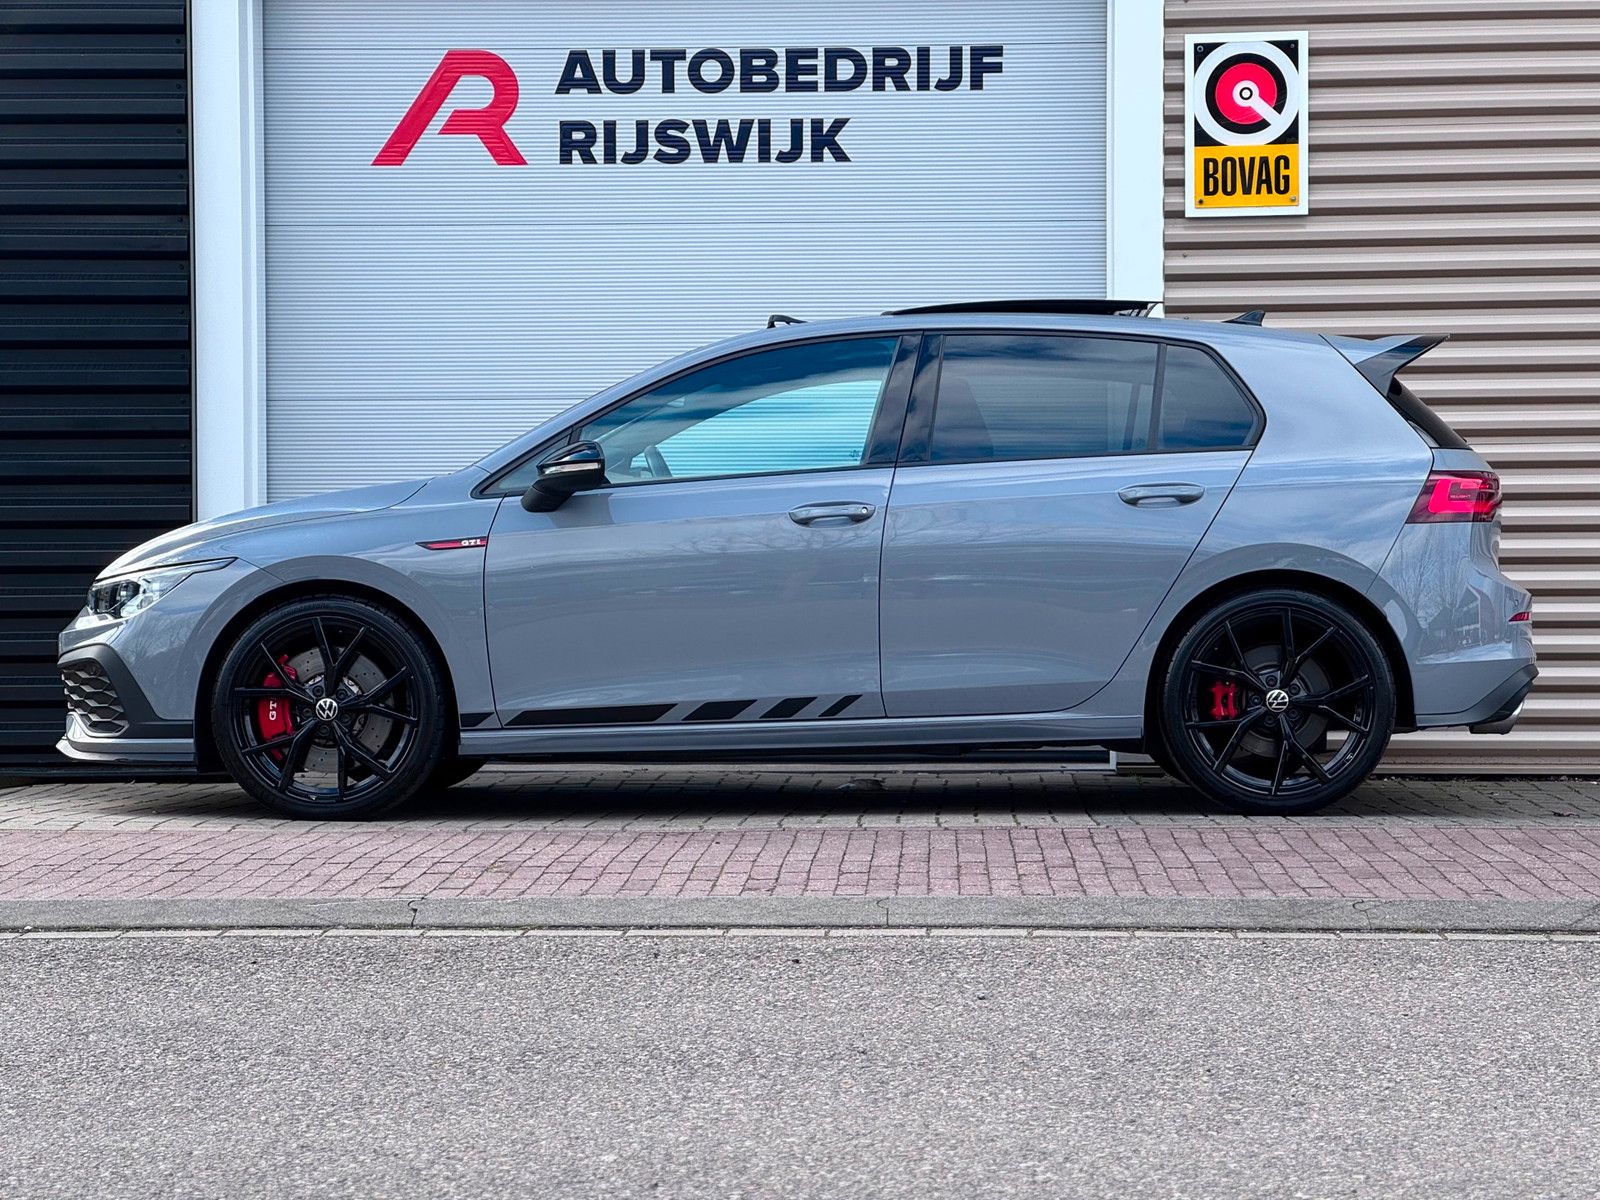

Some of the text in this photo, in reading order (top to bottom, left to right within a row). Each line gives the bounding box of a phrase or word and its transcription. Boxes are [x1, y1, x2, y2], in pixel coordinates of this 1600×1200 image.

[555, 45, 1004, 95] AUTOBEDRIJF
[559, 117, 851, 165] RIJSWIJK
[1203, 154, 1290, 196] BOVAG
